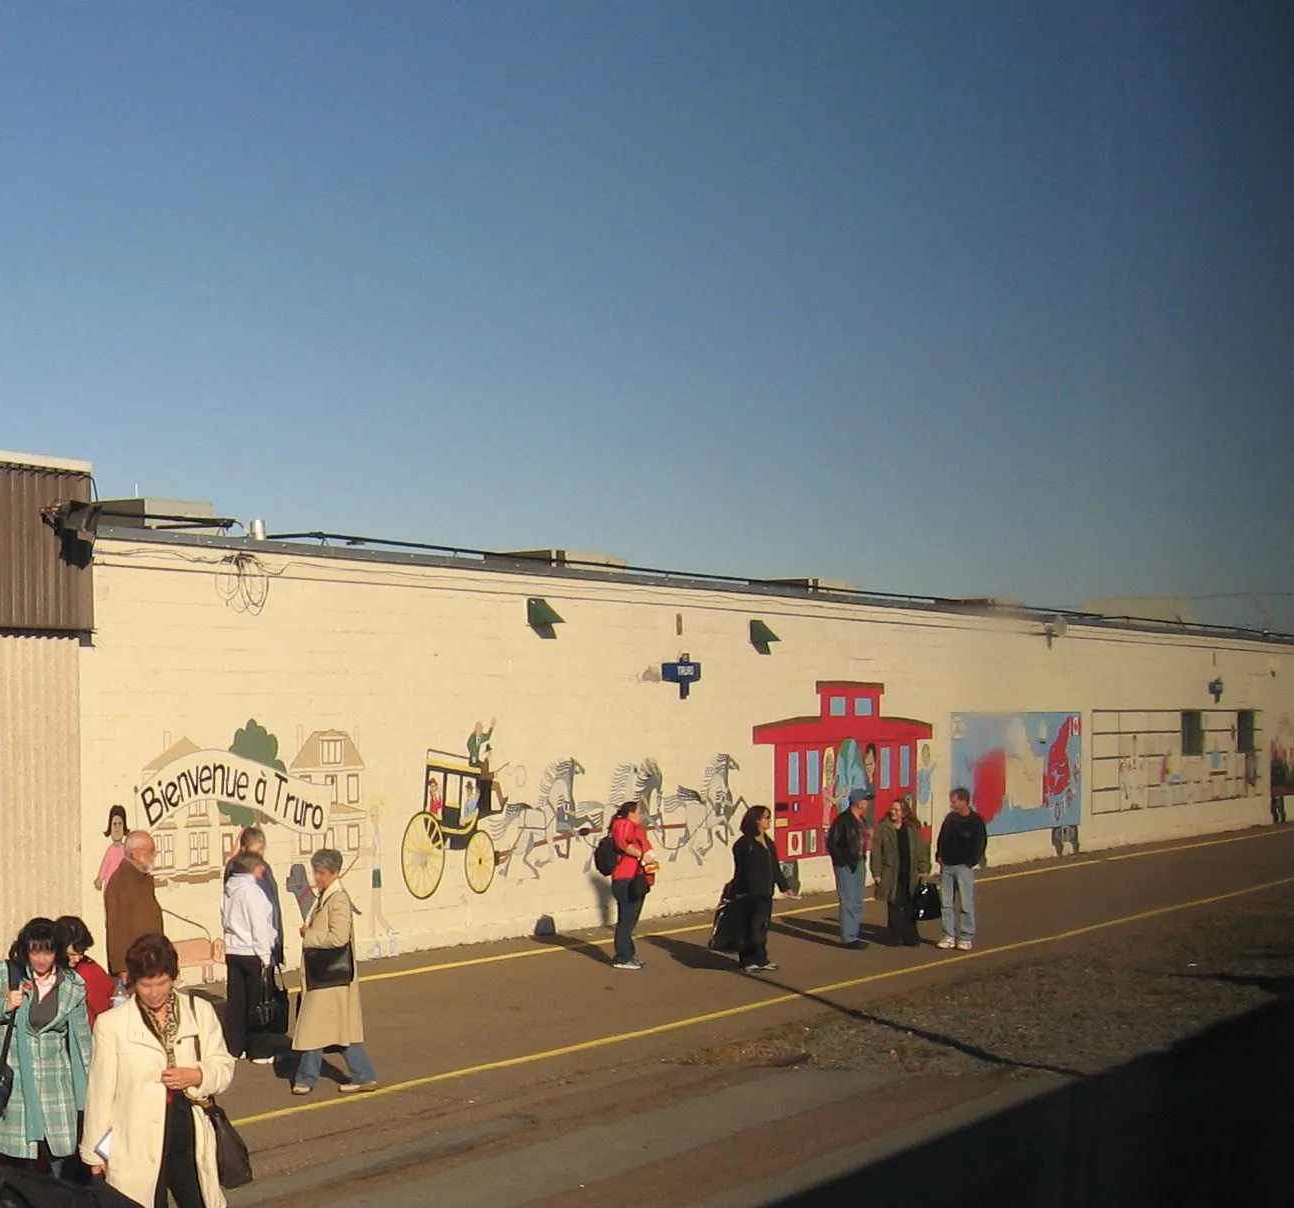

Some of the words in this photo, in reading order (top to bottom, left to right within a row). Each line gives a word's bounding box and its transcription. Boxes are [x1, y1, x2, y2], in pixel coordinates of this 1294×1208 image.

[141, 763, 249, 826] Bienvenue
[255, 770, 266, 806] à
[274, 773, 324, 830] Truro
